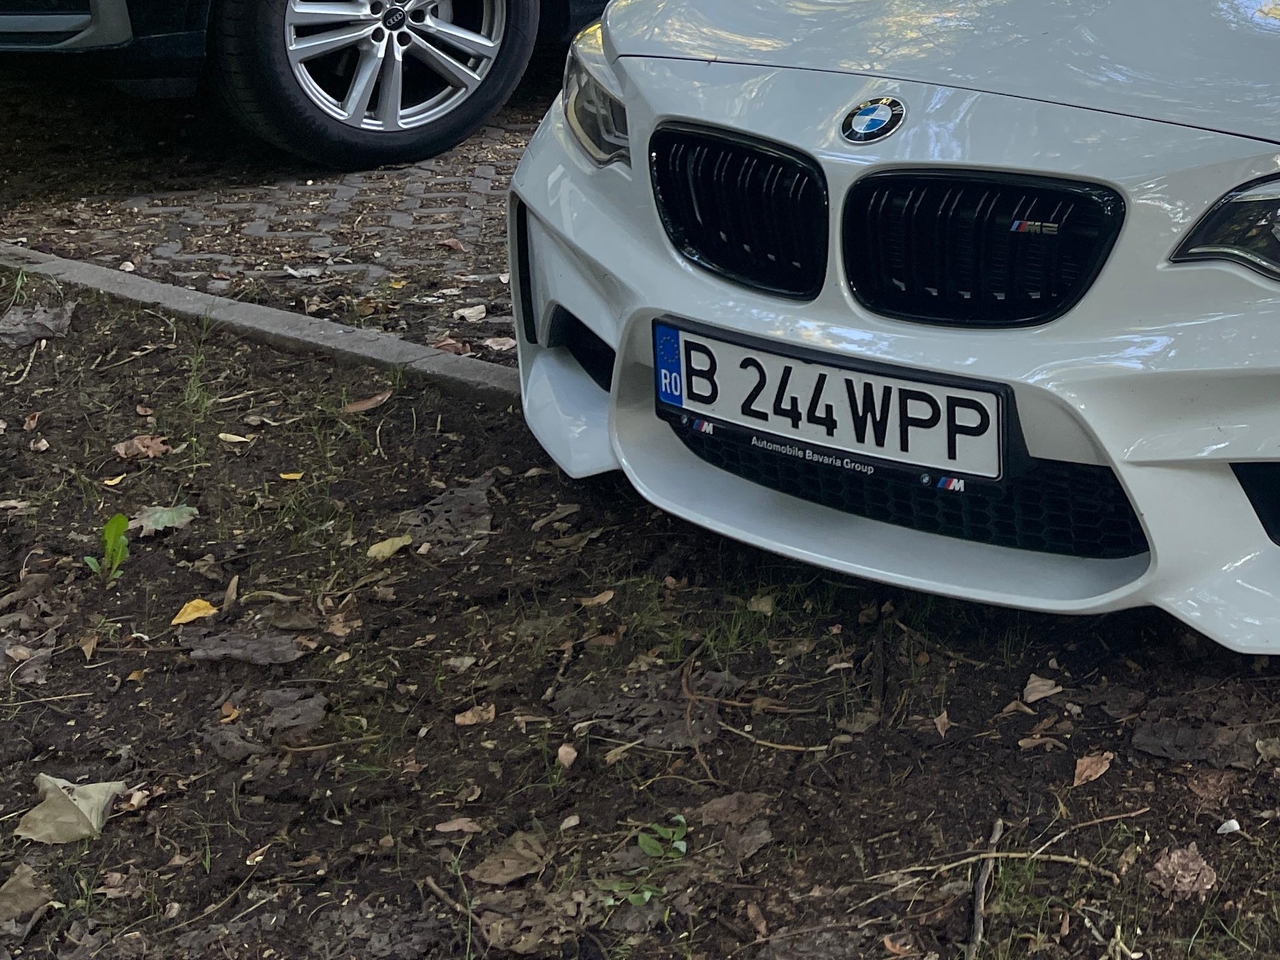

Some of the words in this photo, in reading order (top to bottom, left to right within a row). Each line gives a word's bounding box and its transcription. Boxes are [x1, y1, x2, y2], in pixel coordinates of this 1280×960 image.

[661, 369, 680, 396] RO
[684, 339, 719, 405] B
[751, 436, 804, 458] Automobile
[805, 449, 842, 467] Bavaria
[843, 458, 875, 475] Group
